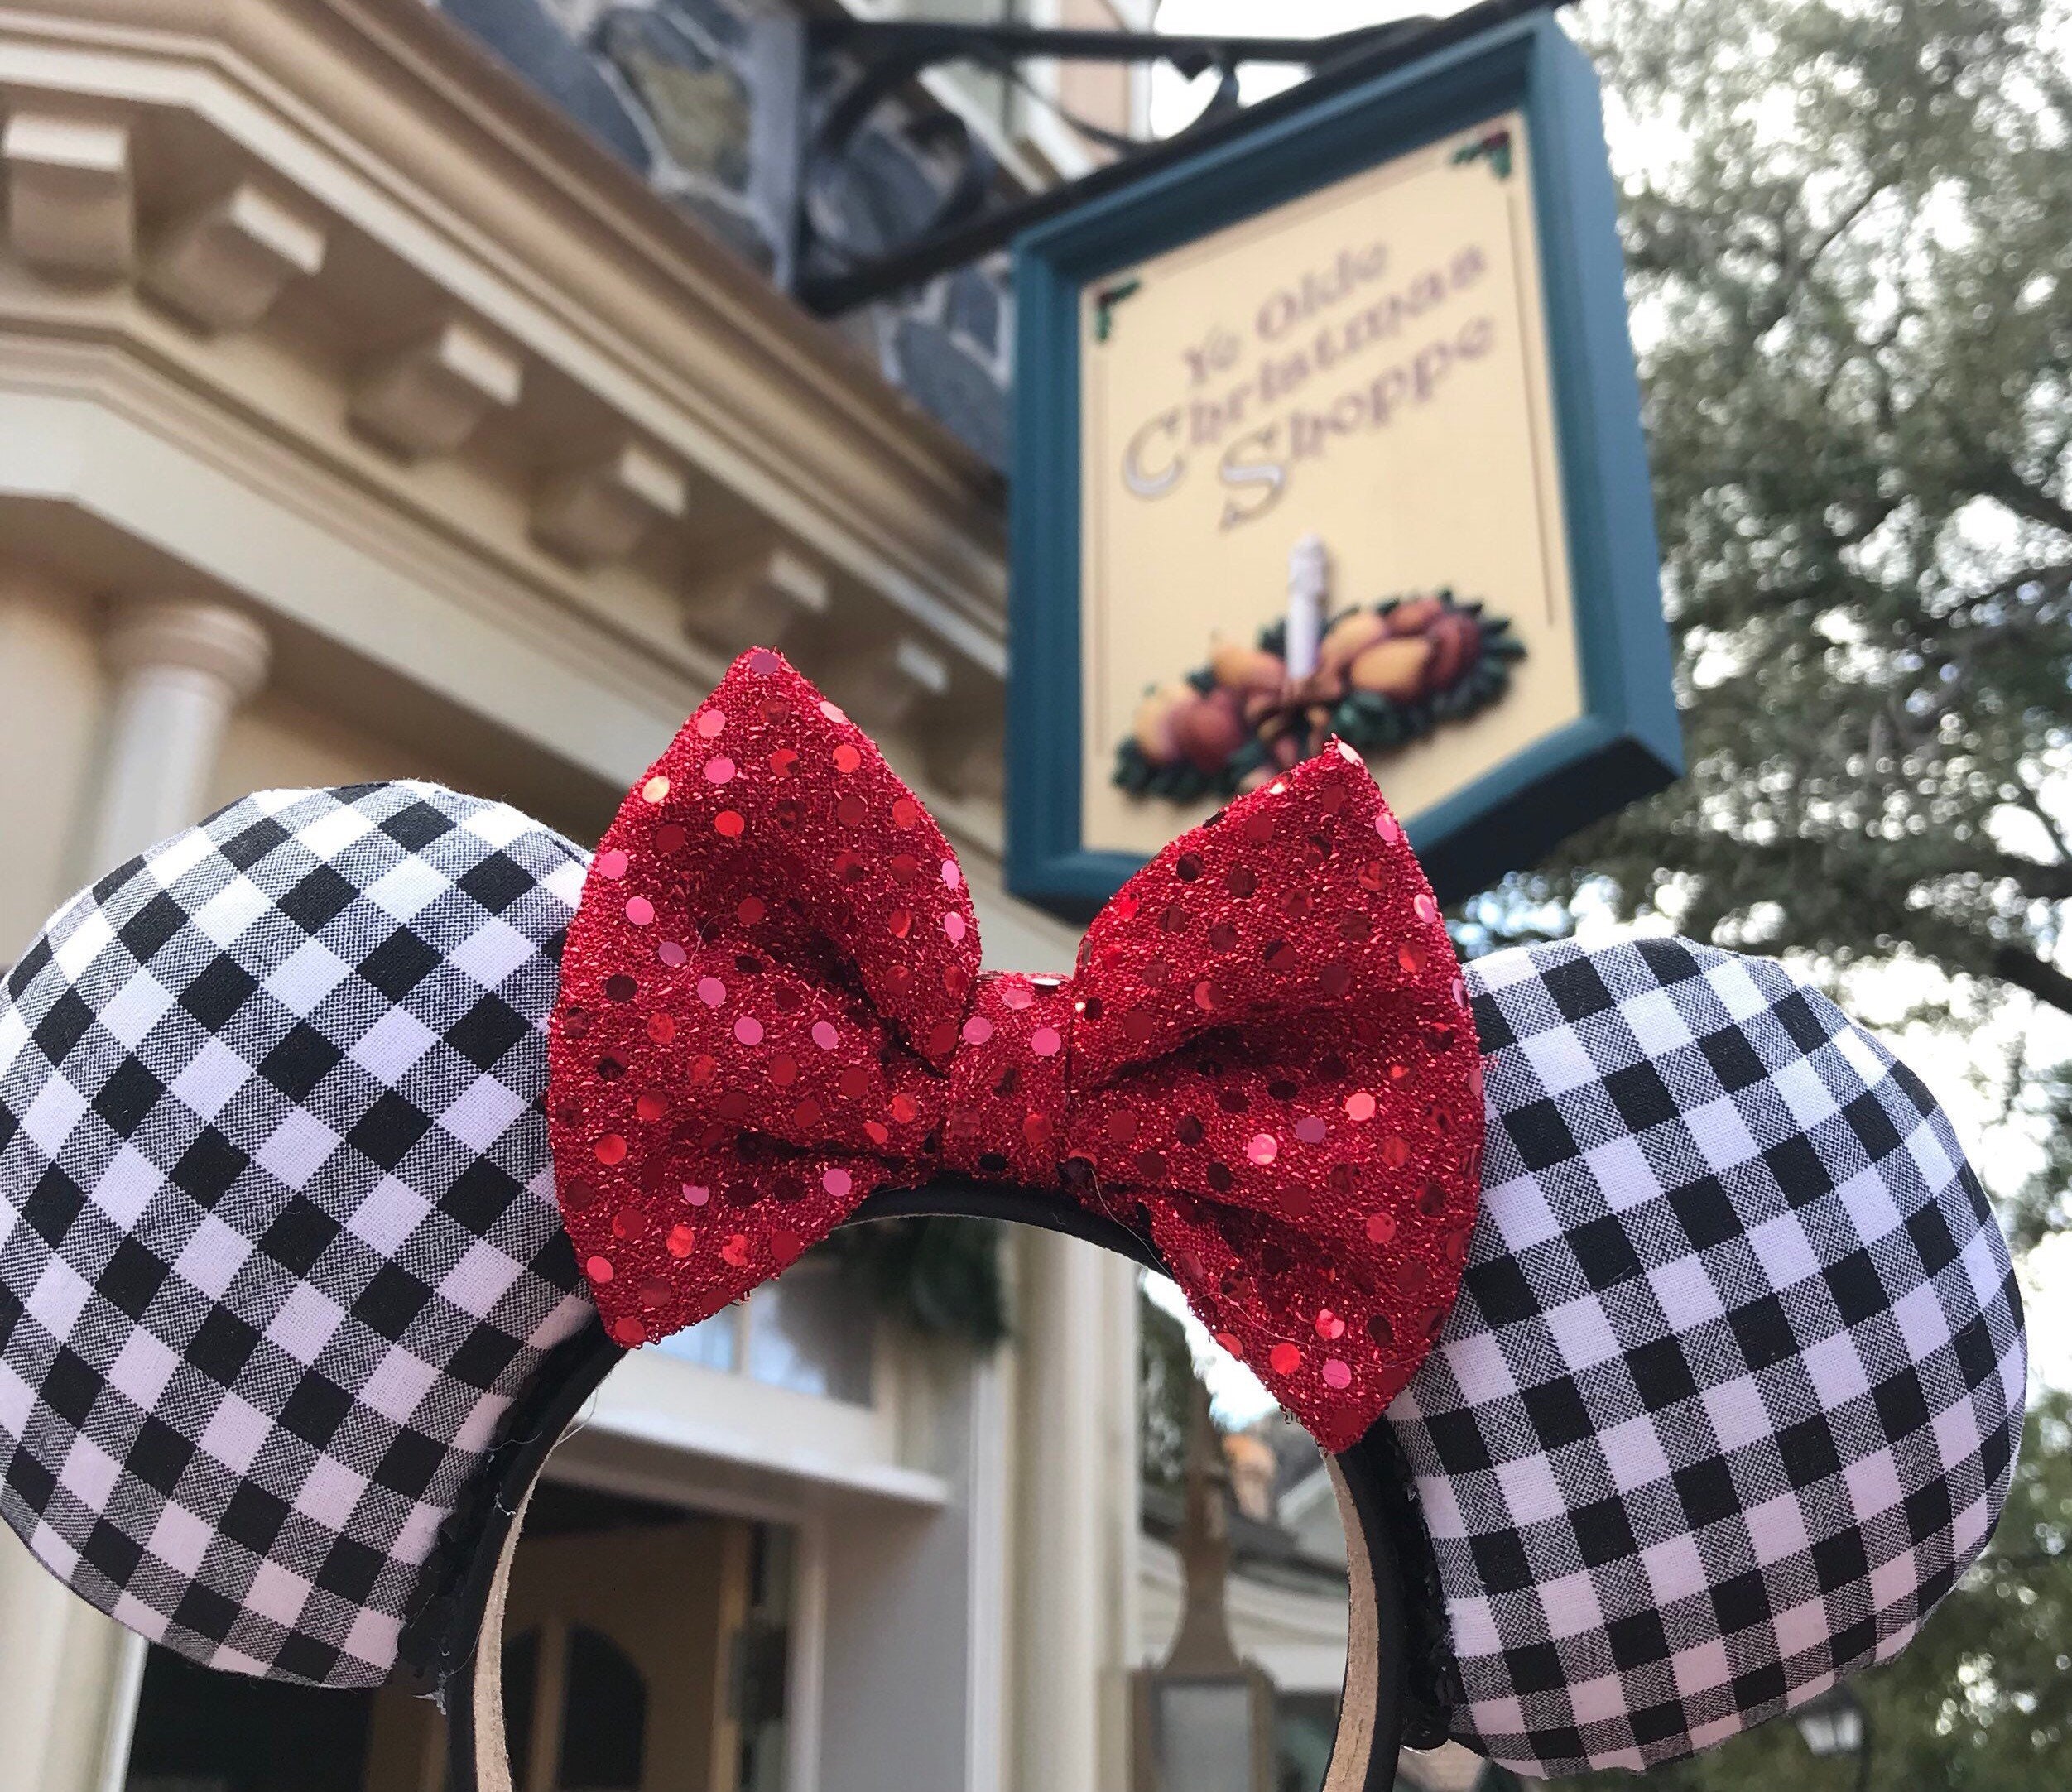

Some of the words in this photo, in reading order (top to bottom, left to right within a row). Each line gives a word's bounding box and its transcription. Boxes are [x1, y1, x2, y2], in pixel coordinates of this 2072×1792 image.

[1122, 245, 1487, 501] Christmas
[1184, 327, 1240, 386] Ye
[1254, 244, 1388, 343] Olde
[1219, 317, 1492, 531] Shoppe
